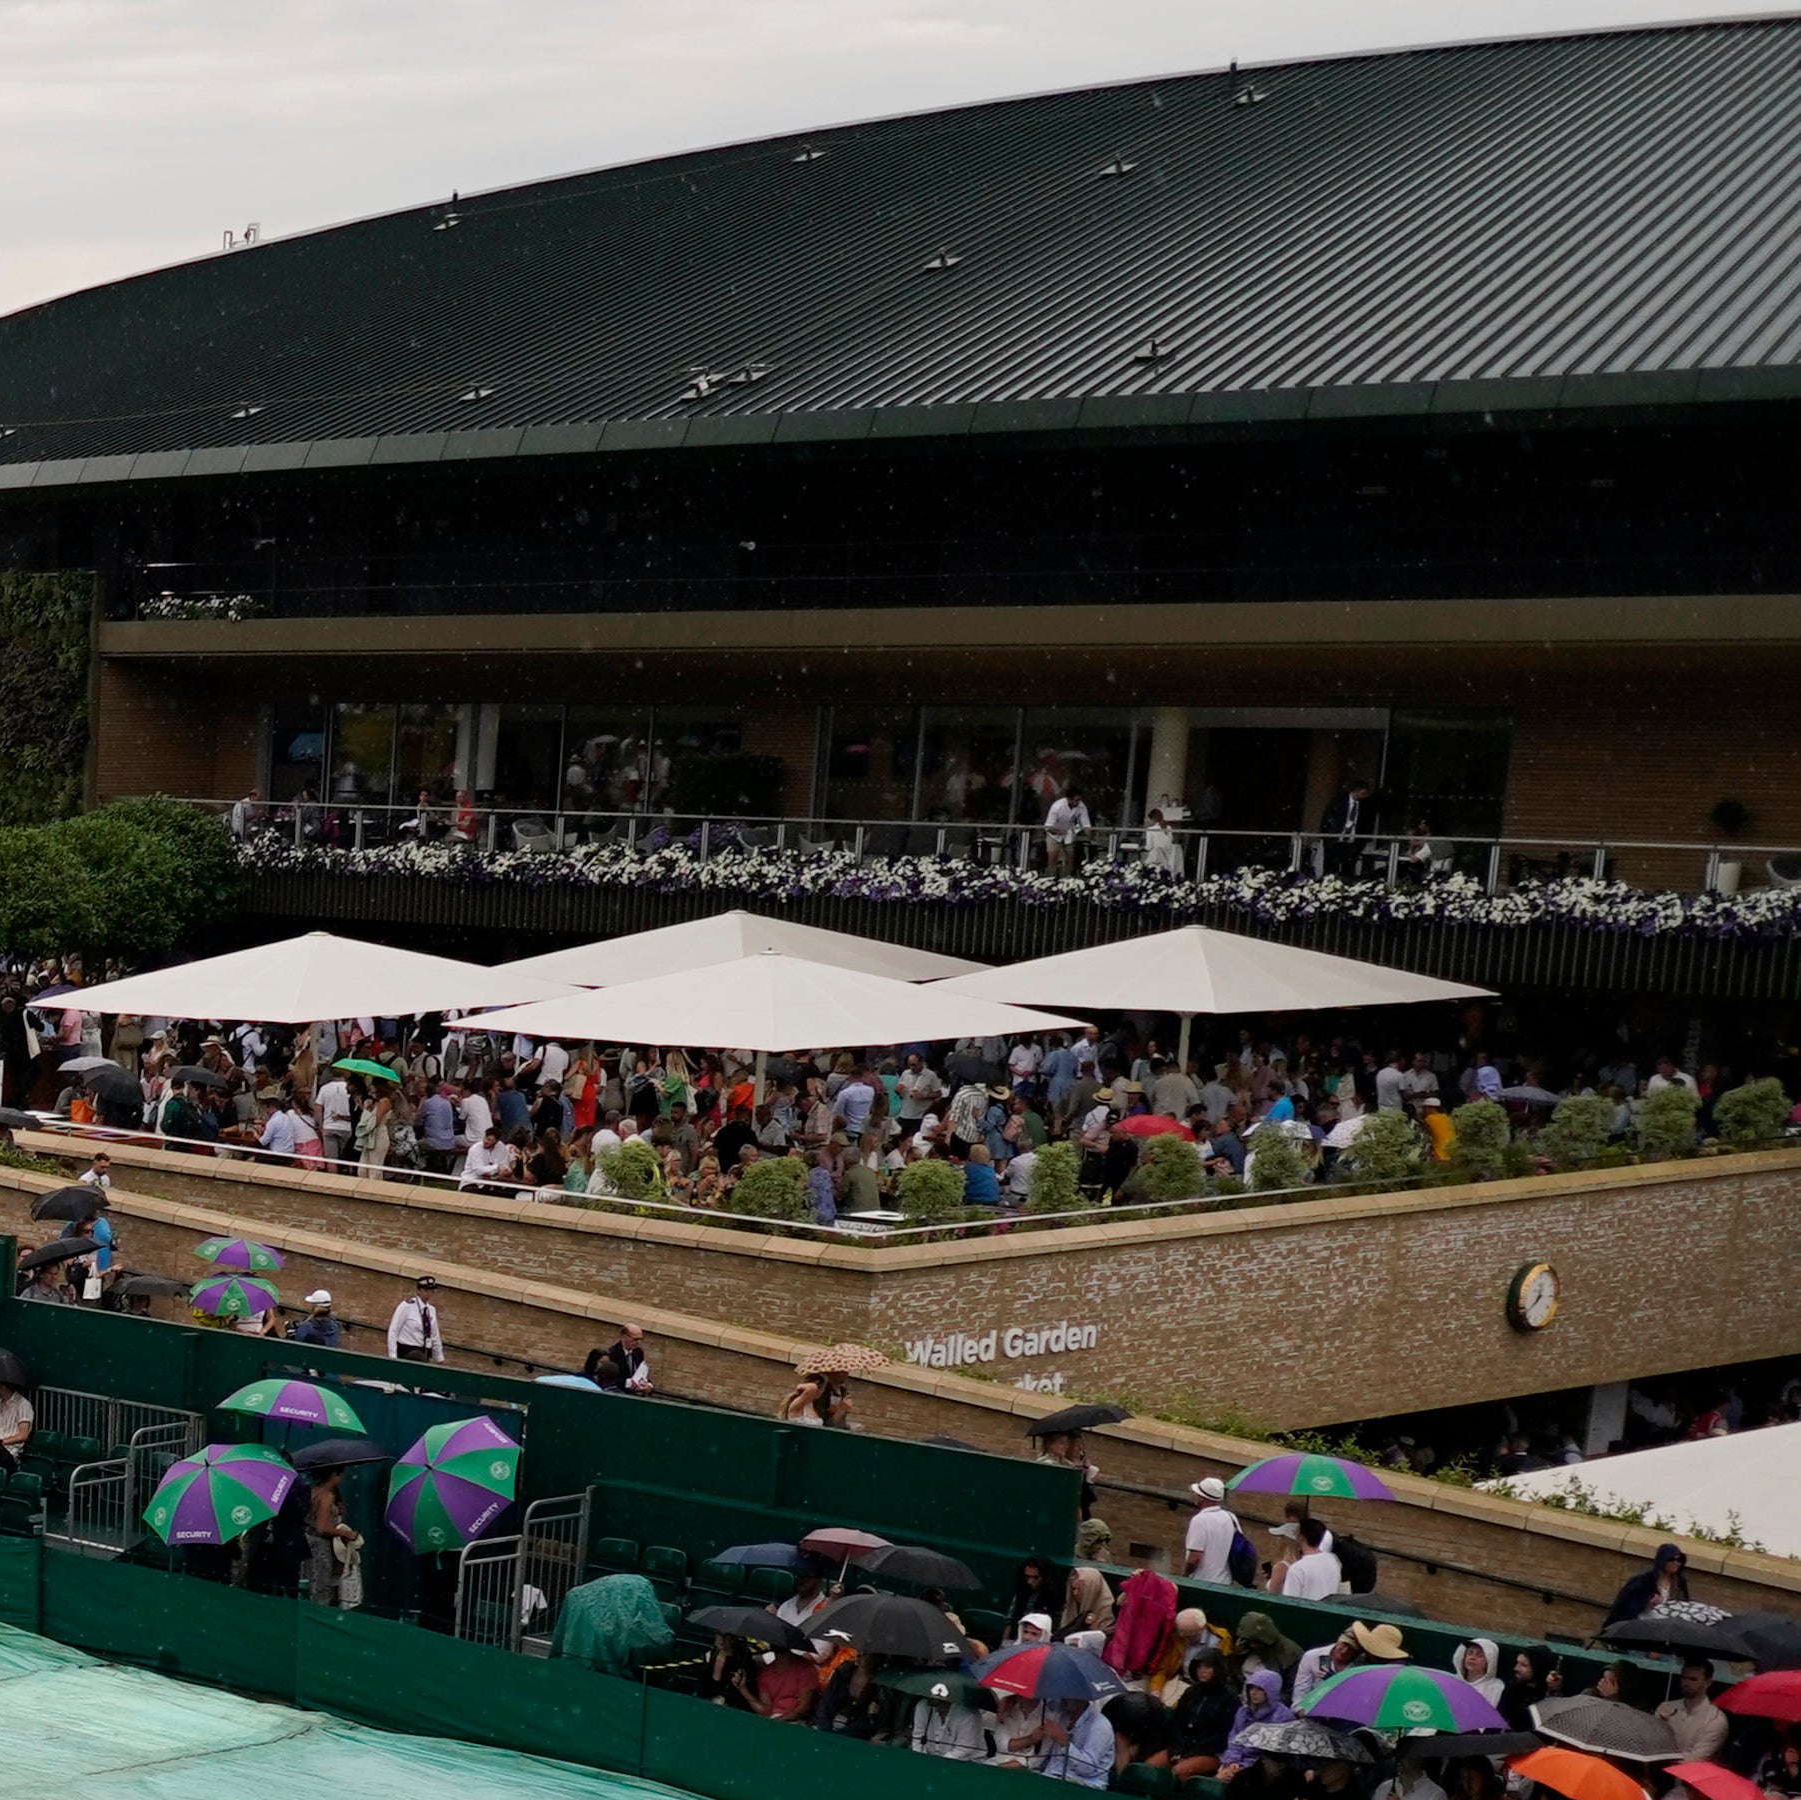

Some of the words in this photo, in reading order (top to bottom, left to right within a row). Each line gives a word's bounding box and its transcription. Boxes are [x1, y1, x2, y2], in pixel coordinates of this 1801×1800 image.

[905, 1330, 997, 1368] Walled
[1004, 1322, 1097, 1358] Garden
[280, 1407, 319, 1418] SECURITY
[271, 1475, 289, 1503] SECURITY
[468, 1502, 499, 1534] SECURITY
[176, 1531, 212, 1539] SECURITY
